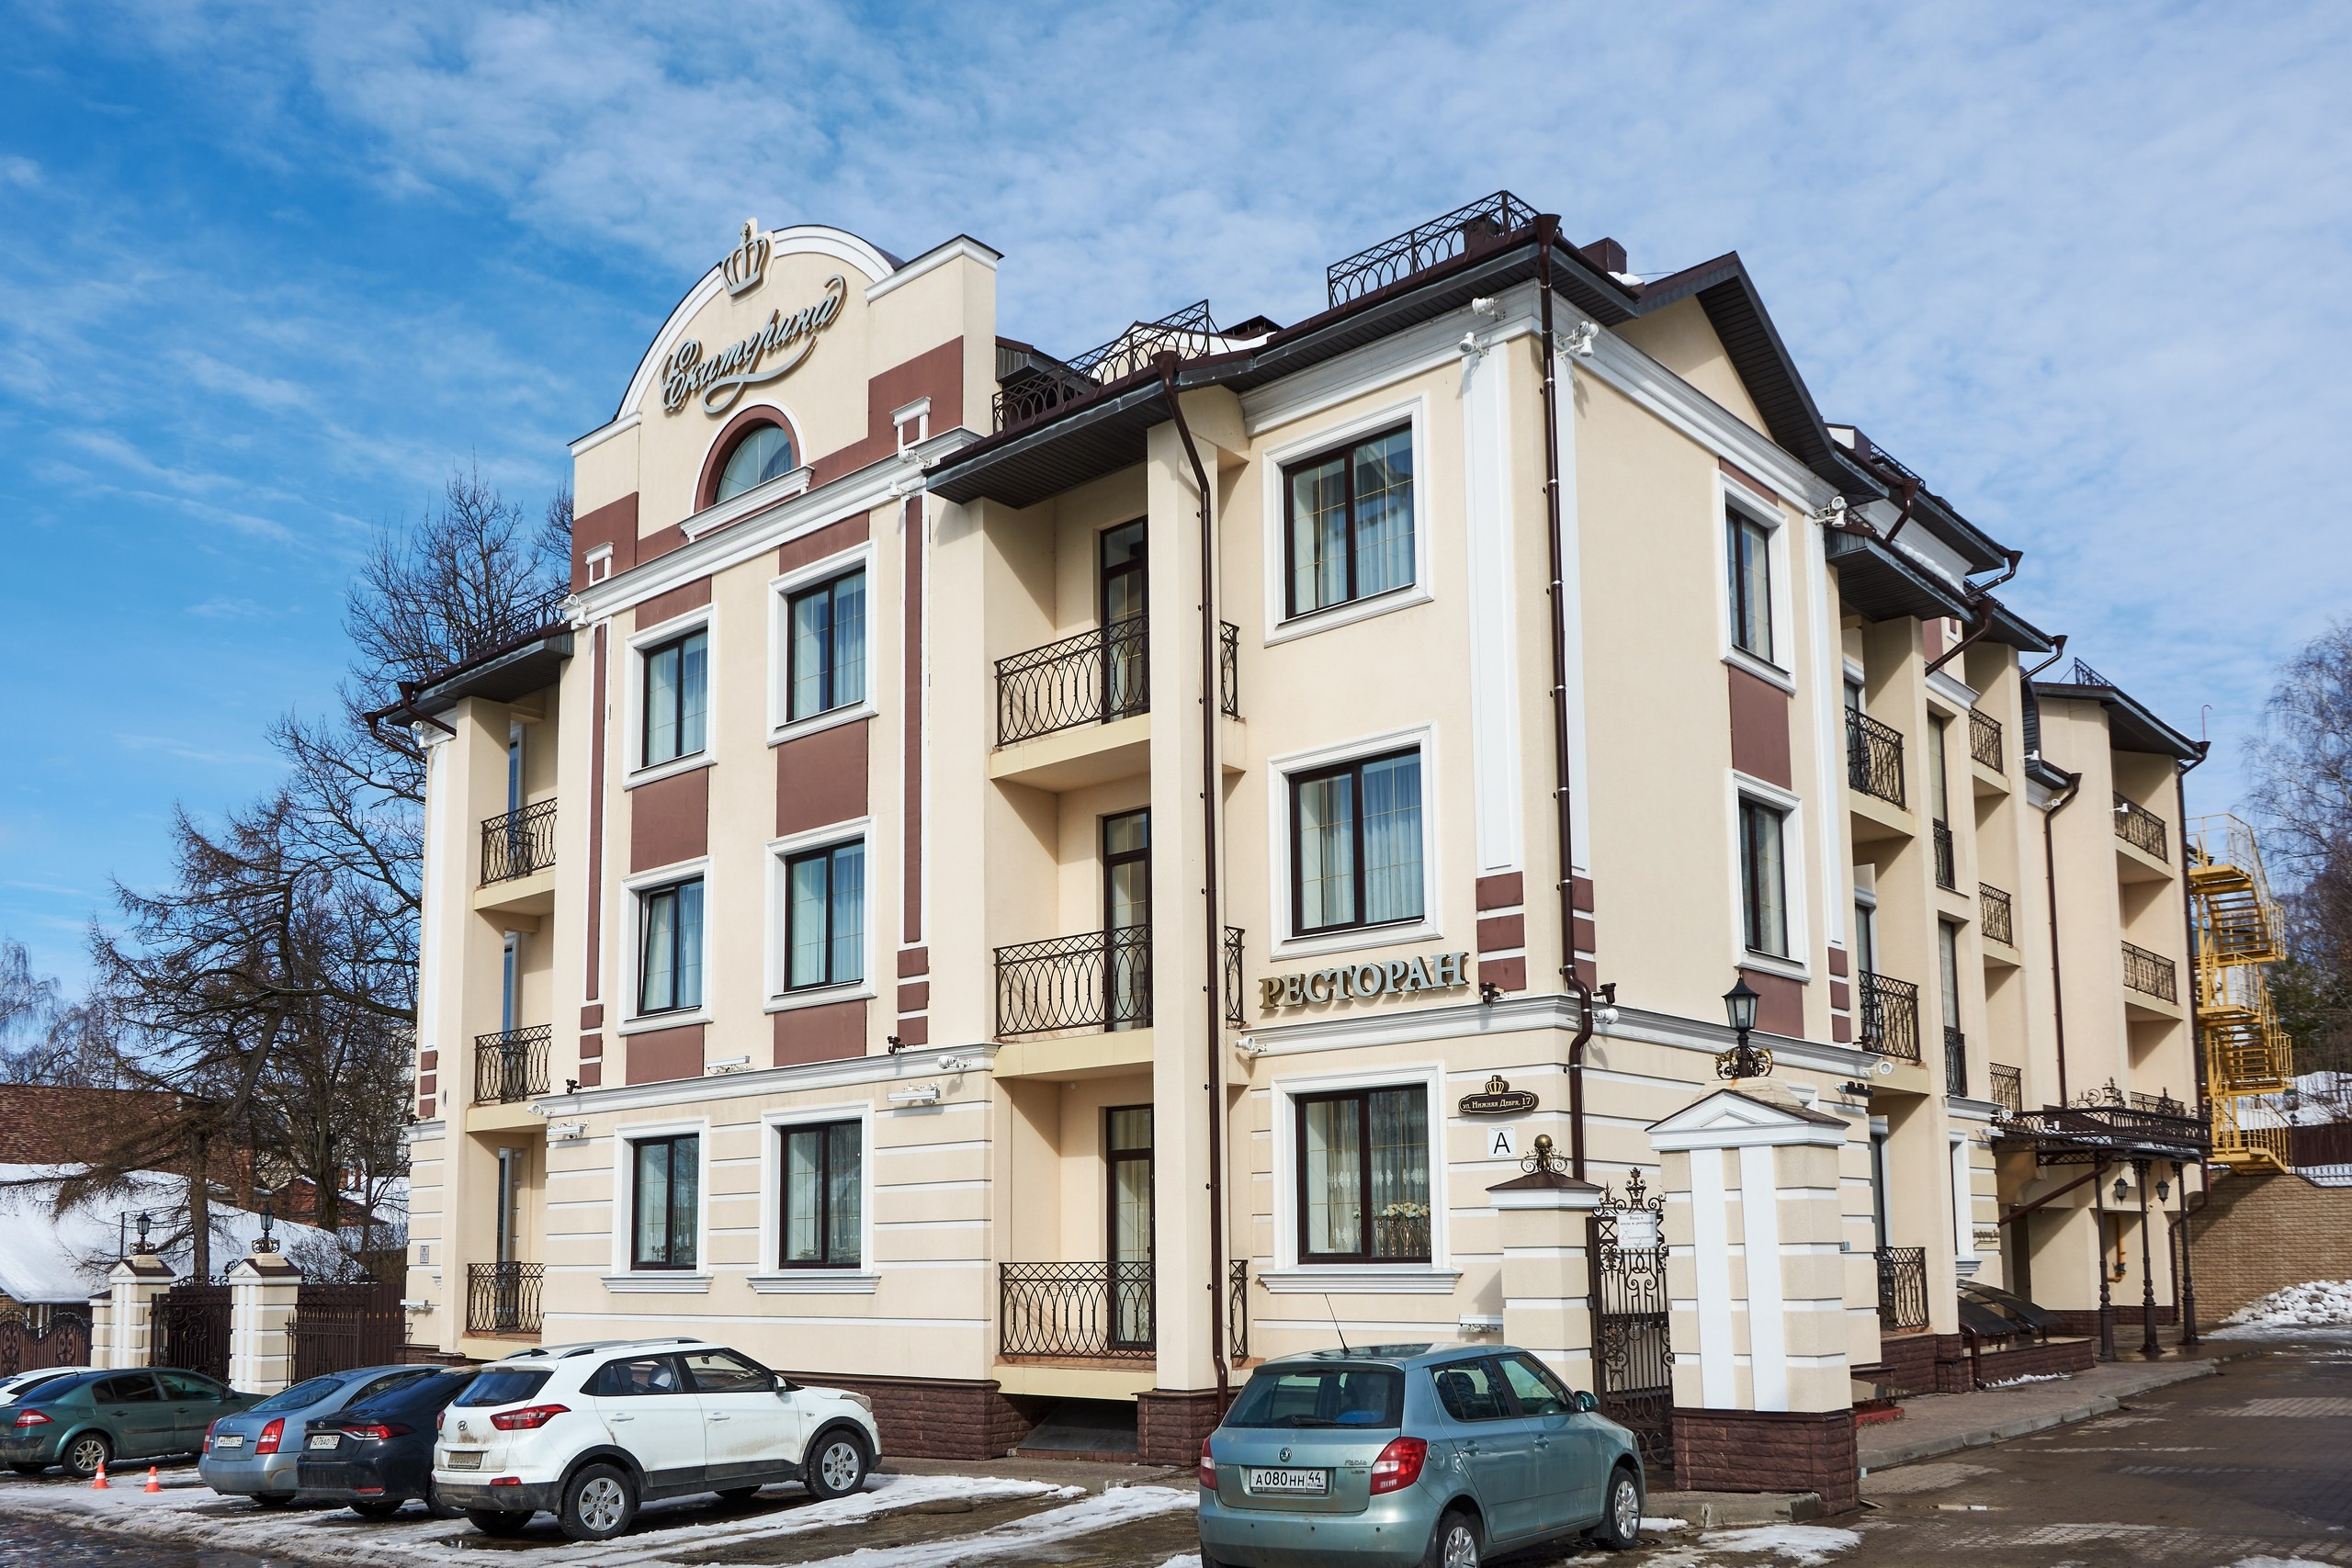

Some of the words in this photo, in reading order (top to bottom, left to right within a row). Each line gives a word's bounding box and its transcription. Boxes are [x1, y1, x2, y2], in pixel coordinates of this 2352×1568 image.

[659, 274, 847, 414] Екатерина
[1258, 952, 1470, 1010] РЕСТОРАН
[1521, 1097, 1532, 1105] 17
